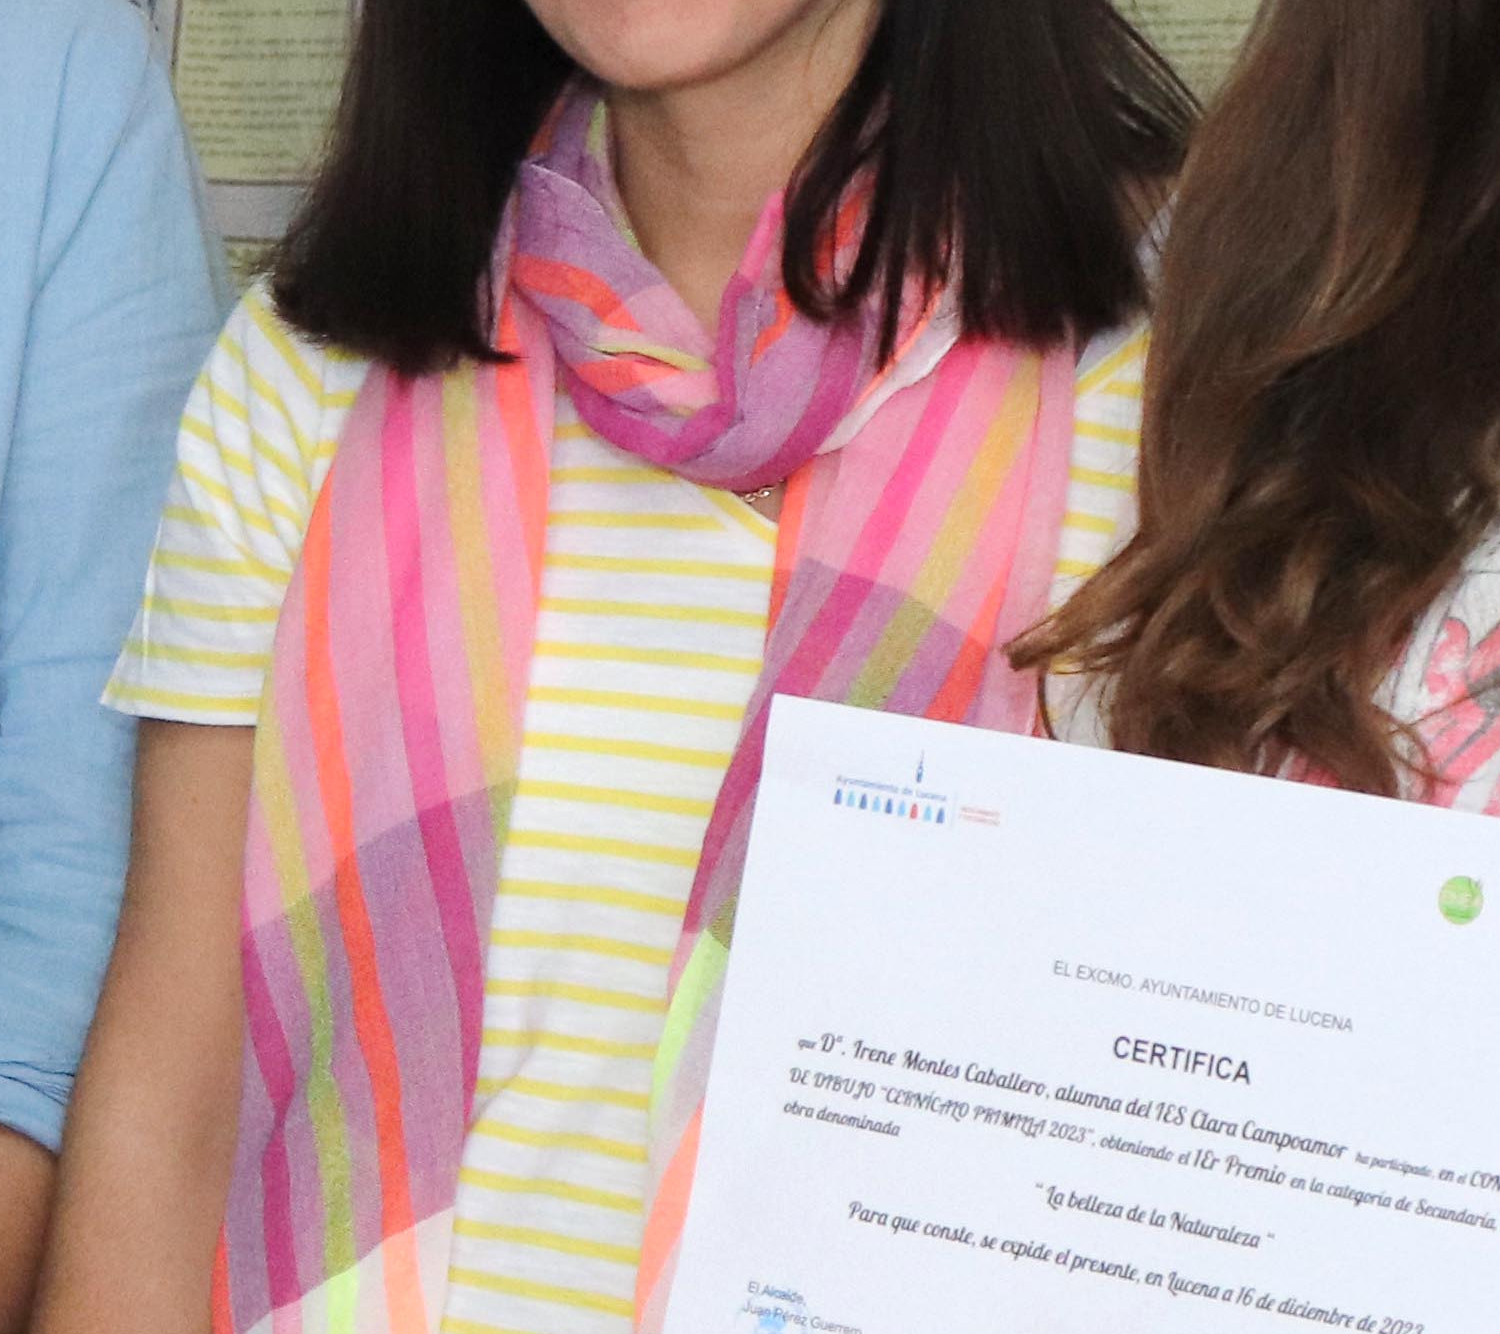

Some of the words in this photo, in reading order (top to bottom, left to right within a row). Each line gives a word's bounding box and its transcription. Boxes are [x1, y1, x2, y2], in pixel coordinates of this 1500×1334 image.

[1053, 959, 1073, 977] EL
[1139, 977, 1261, 1014] AYUNTAMIENTO
[1264, 1001, 1287, 1020] DE
[1290, 1007, 1354, 1033] LUCENA
[1113, 1035, 1252, 1085] CERTIFICA
[783, 1099, 815, 1120] obra
[816, 1105, 901, 1137] denominada
[789, 1066, 809, 1087] DE
[813, 1072, 876, 1100] DIBUJO
[1100, 1133, 1174, 1163] obteniendo
[1177, 1149, 1192, 1166] el
[1224, 1153, 1286, 1186] Premio
[1290, 1176, 1306, 1192] en
[1309, 1178, 1324, 1195] la
[1394, 1196, 1412, 1213] de
[854, 1039, 898, 1066] Irene
[901, 1049, 960, 1079] Montes
[964, 1062, 1051, 1100] Caballero,
[1054, 1084, 1122, 1114] alumna
[1125, 1097, 1152, 1119] del
[1190, 1109, 1239, 1137] Clara
[1242, 1120, 1348, 1160] Campoamor
[1439, 1167, 1454, 1183] en
[1068, 1191, 1123, 1219] belleza
[1126, 1204, 1146, 1225] de
[1149, 1209, 1166, 1228] la
[1170, 1211, 1262, 1249] Naturaleza
[747, 1280, 760, 1295] El
[848, 1199, 889, 1227] Para
[891, 1215, 921, 1236] que
[923, 1221, 976, 1248] conste,
[980, 1232, 998, 1250] se
[1000, 1237, 1053, 1263] expide
[1055, 1248, 1072, 1267] el
[1069, 1253, 1141, 1285] presente,
[1144, 1269, 1163, 1288] en
[1167, 1271, 1220, 1302] Lucena
[1221, 1287, 1233, 1303] a
[1235, 1286, 1255, 1307] 16
[1255, 1291, 1276, 1312] de
[1277, 1297, 1353, 1330] diciembre
[1356, 1312, 1379, 1334] de
[741, 1300, 772, 1317] Juan
[774, 1305, 807, 1327] Pérez
